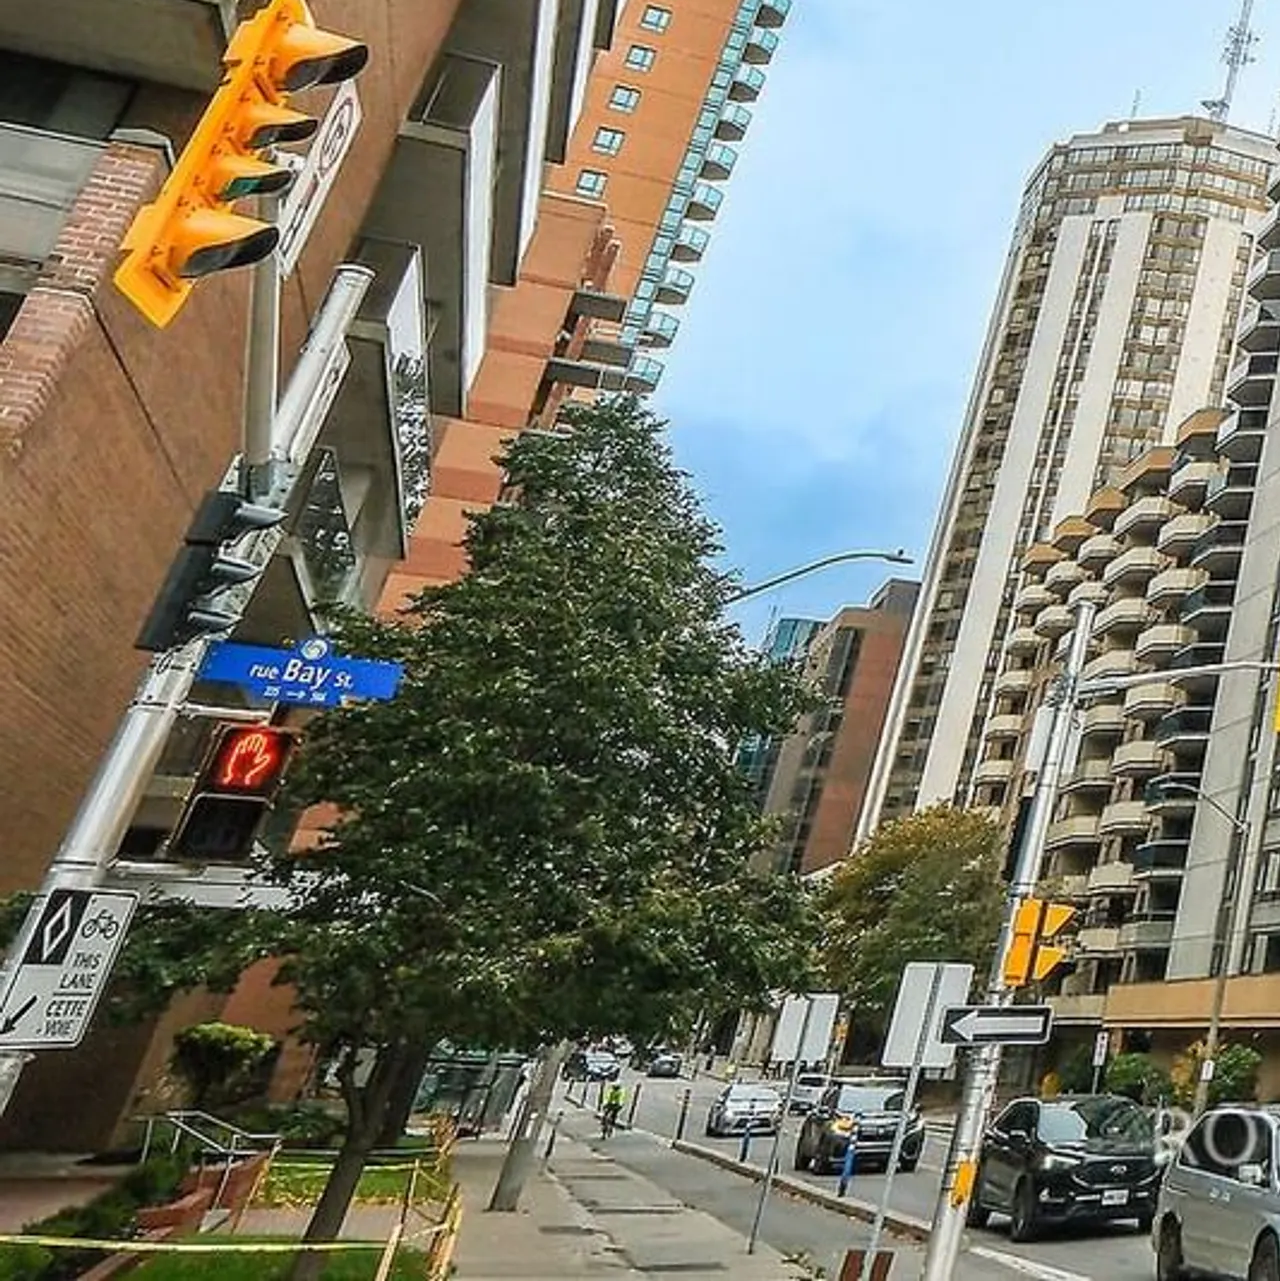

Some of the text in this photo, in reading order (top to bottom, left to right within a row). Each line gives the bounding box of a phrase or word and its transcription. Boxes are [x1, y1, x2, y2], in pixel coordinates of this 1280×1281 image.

[249, 664, 280, 680] rue
[282, 658, 330, 690] Bay
[72, 952, 102, 970] THIS
[59, 972, 96, 990] LANE
[45, 999, 88, 1018] CETTE
